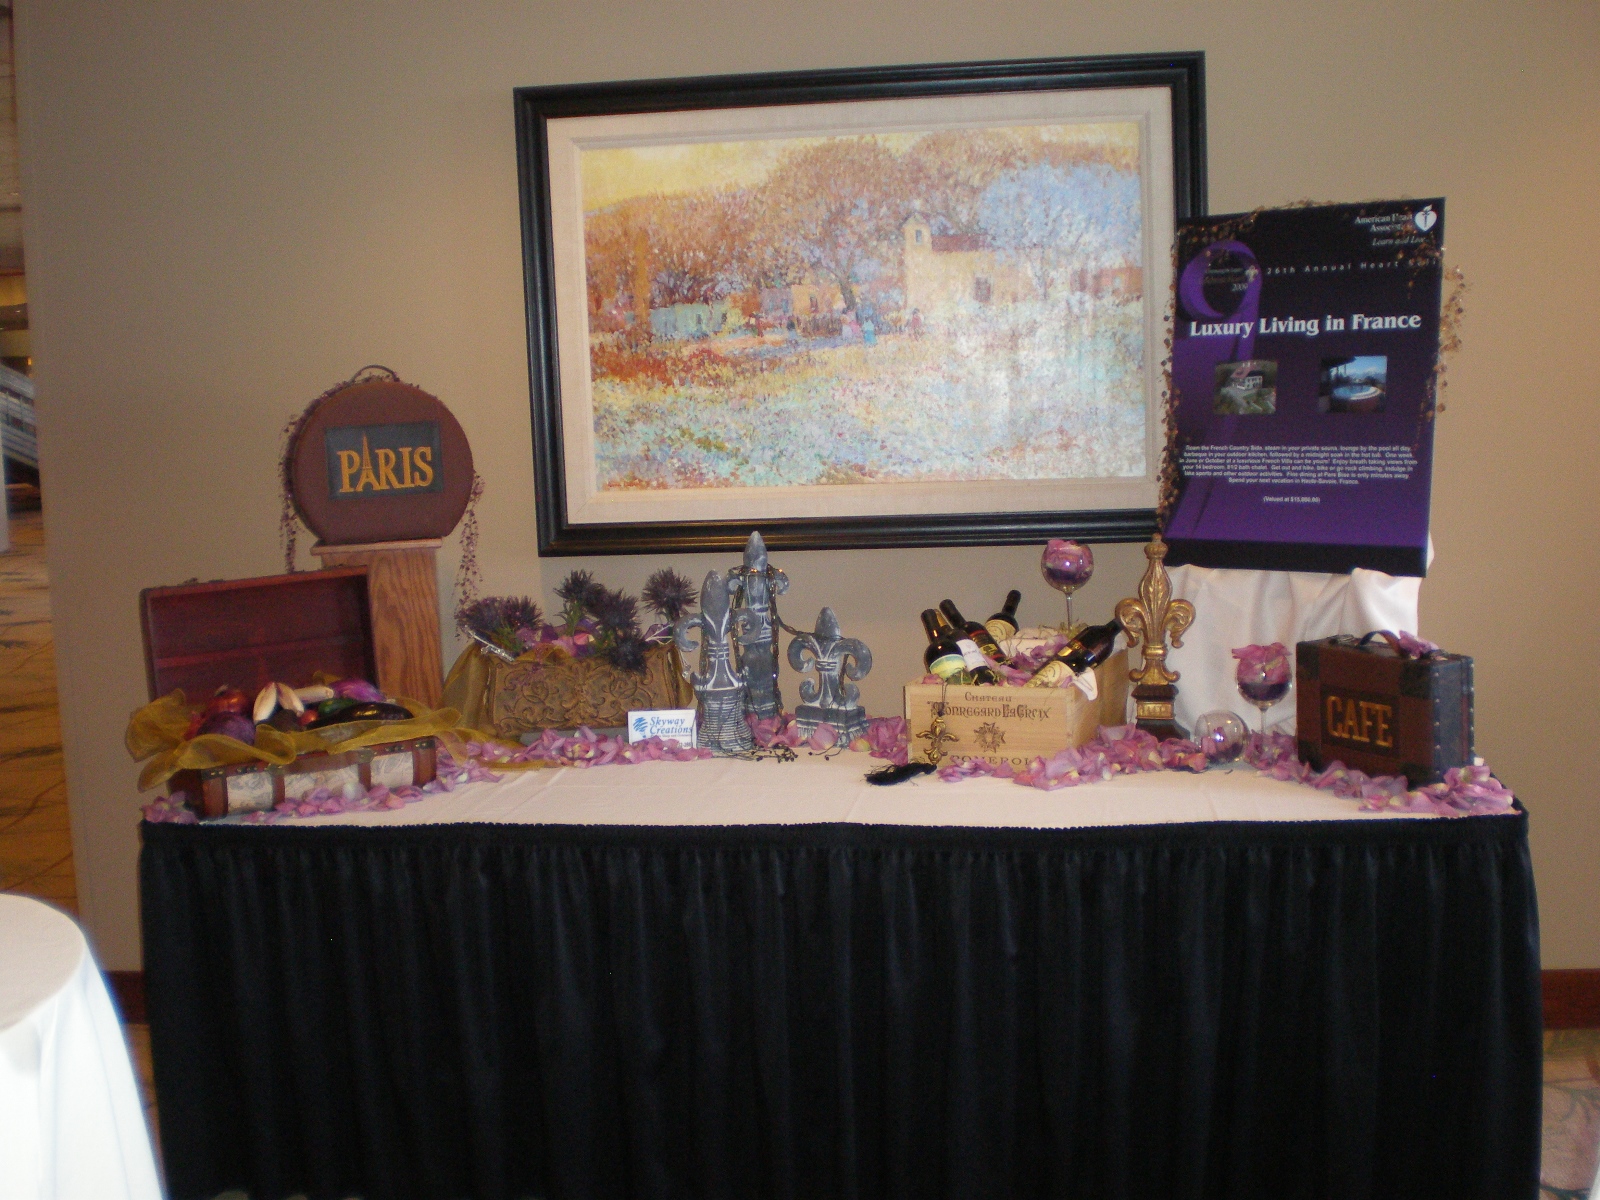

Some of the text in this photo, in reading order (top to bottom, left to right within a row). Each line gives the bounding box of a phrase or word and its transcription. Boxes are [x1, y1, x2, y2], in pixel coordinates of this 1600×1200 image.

[1304, 263, 1352, 273] Annual
[1360, 260, 1399, 269] Heart
[1189, 313, 1422, 339] Luxury Living in France
[337, 432, 434, 493] PARIS
[649, 716, 685, 727] Skyway
[649, 725, 692, 735] Creations
[1325, 695, 1393, 748] CAFE
